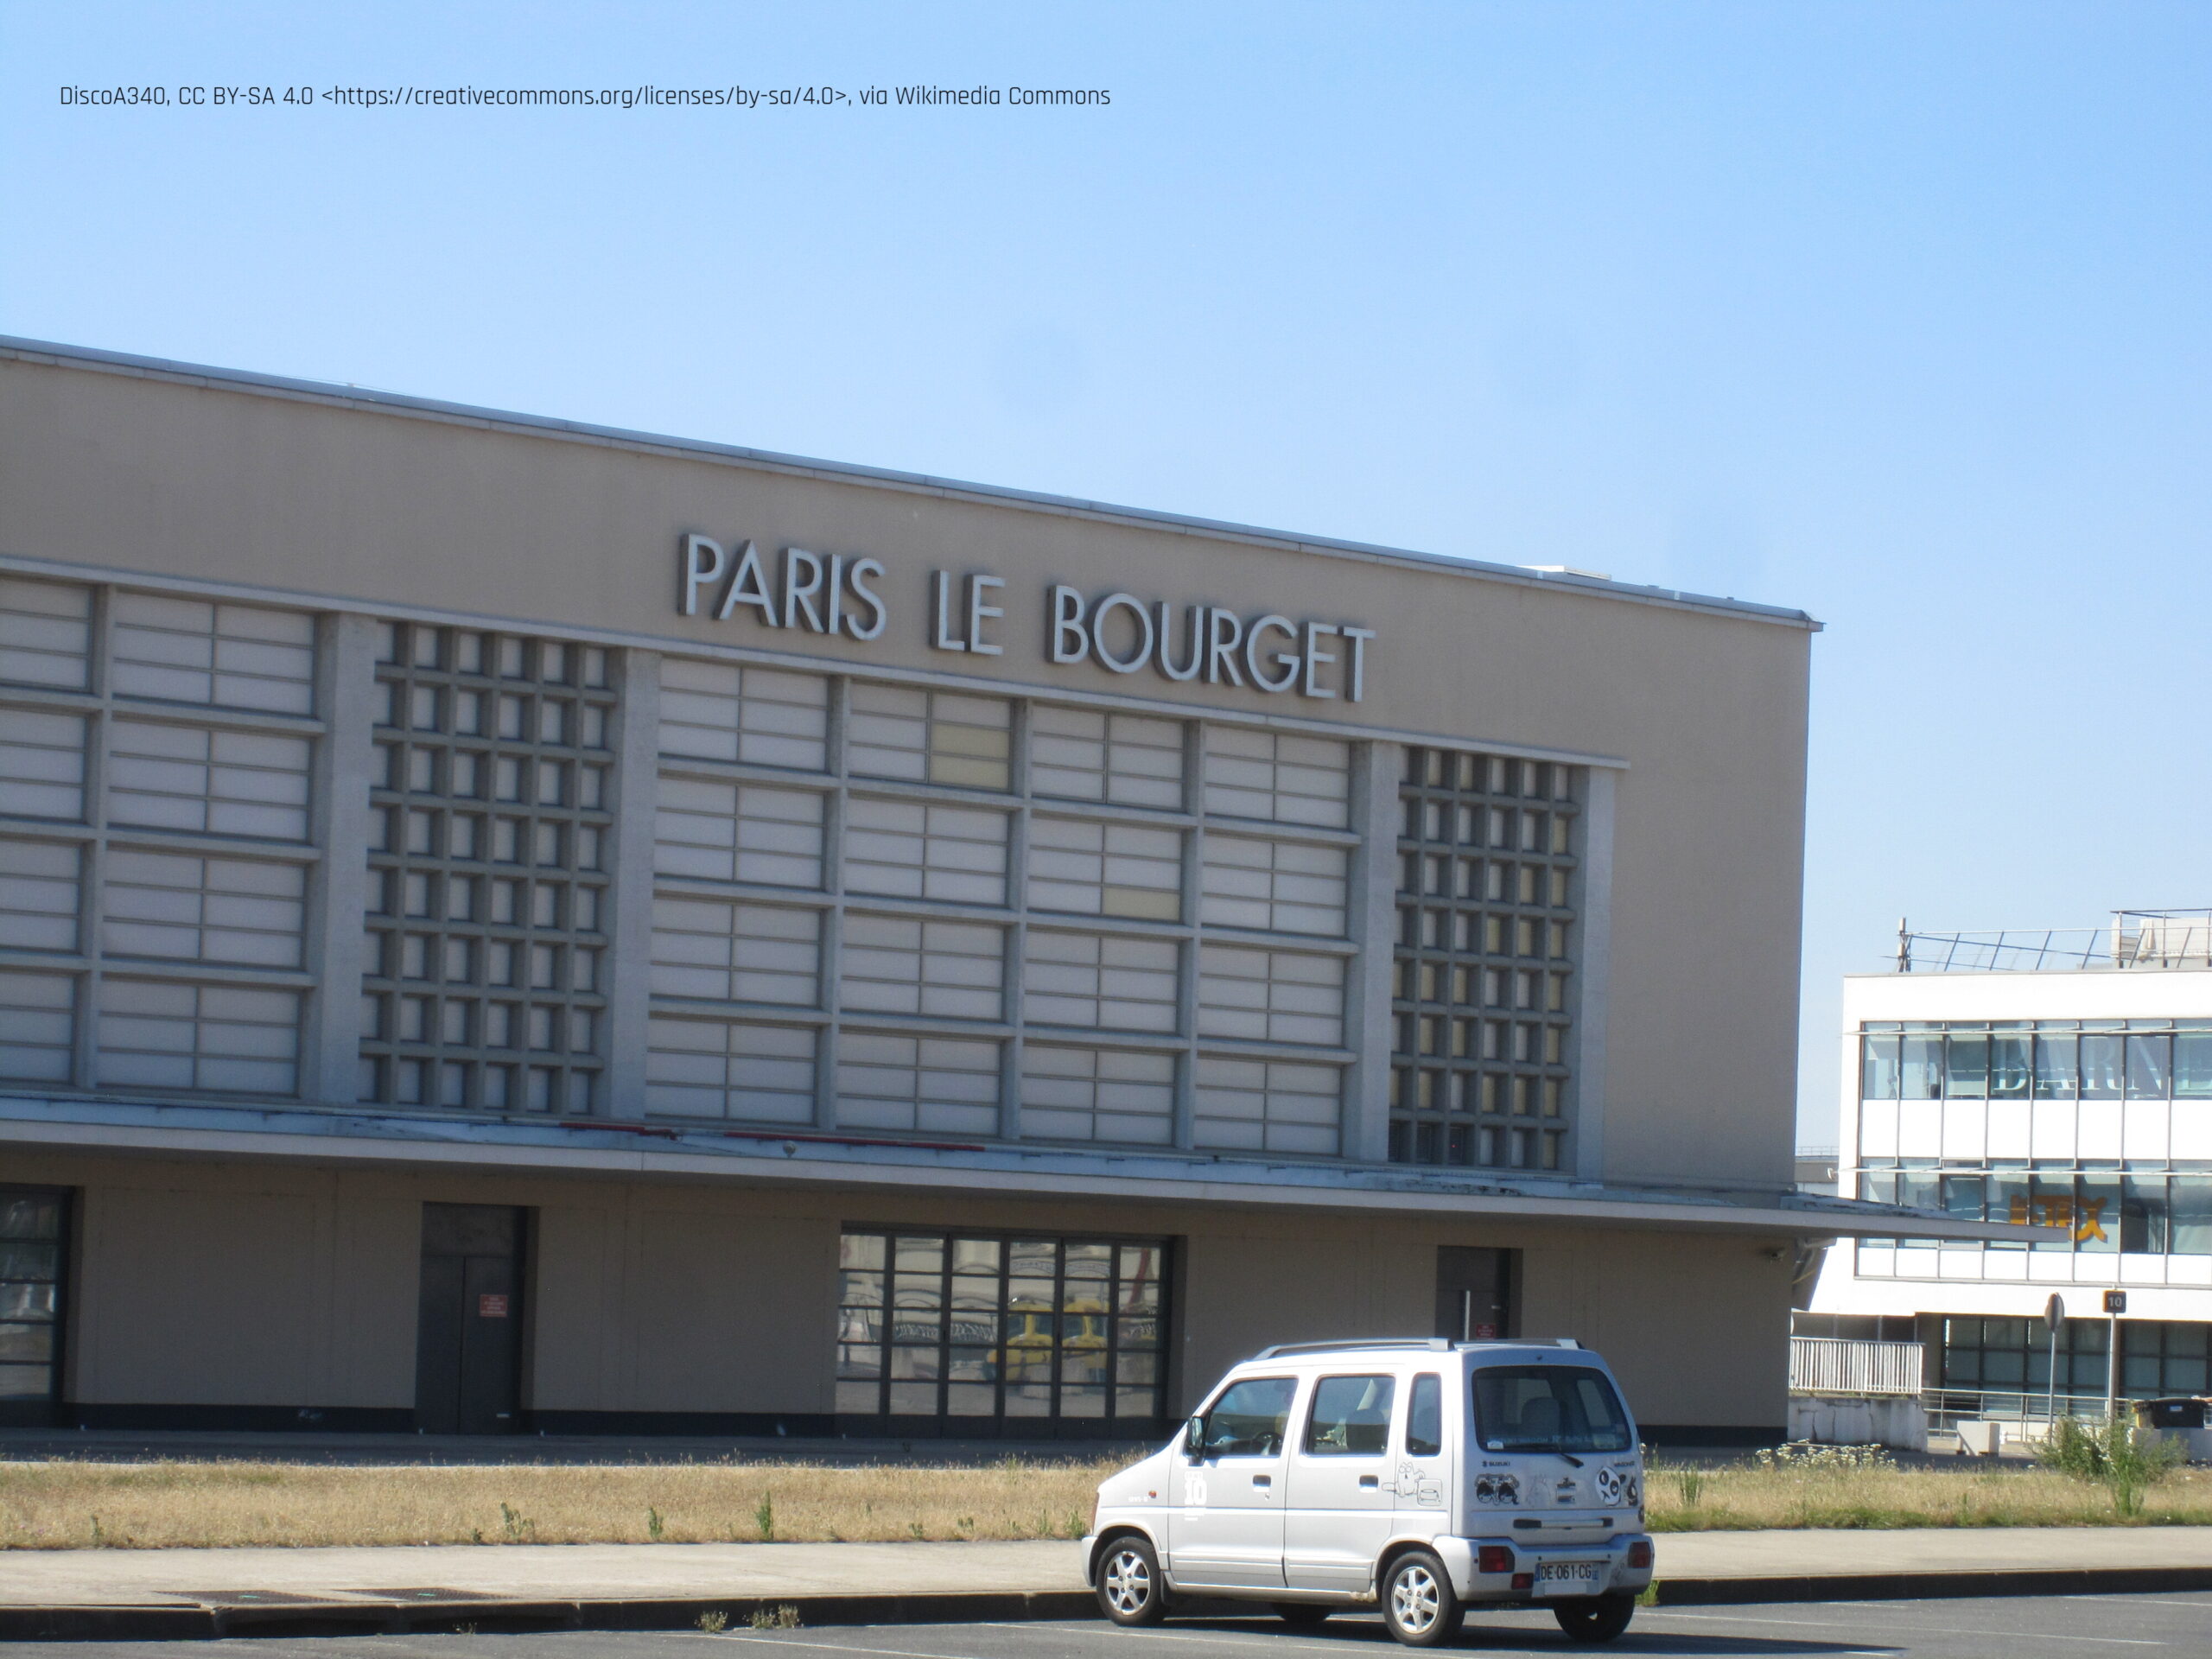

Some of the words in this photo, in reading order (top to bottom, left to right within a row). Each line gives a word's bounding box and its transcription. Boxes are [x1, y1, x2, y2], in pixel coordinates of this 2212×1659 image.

[678, 532, 887, 640] PARIS
[931, 569, 1007, 656] LE
[1046, 584, 1376, 702] BOURGET
[2108, 1296, 2123, 1307] 10
